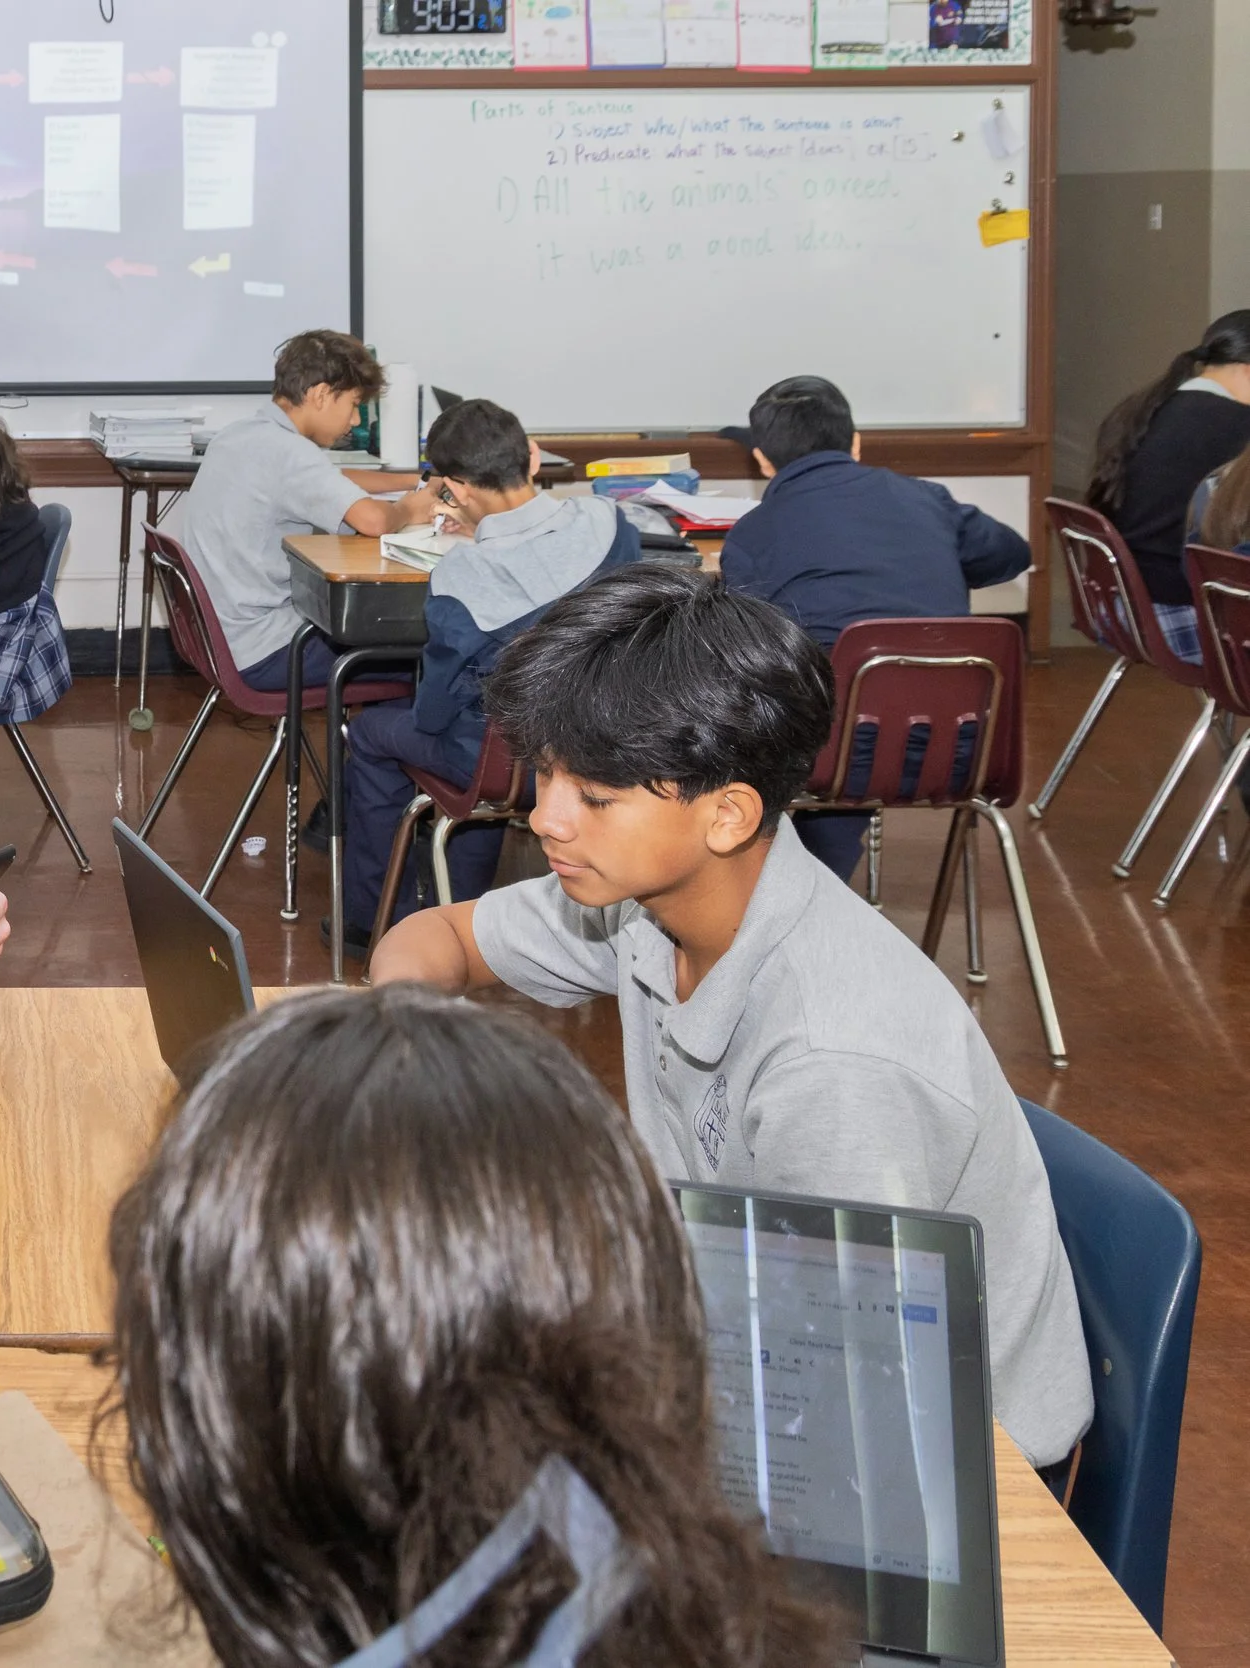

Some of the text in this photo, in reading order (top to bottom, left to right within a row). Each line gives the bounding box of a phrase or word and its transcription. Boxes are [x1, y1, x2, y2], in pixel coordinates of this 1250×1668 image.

[471, 99, 524, 123] Parts
[537, 99, 554, 117] of
[535, 174, 570, 215] All
[597, 175, 652, 215] the
[590, 243, 646, 274] was
[667, 241, 683, 261] a
